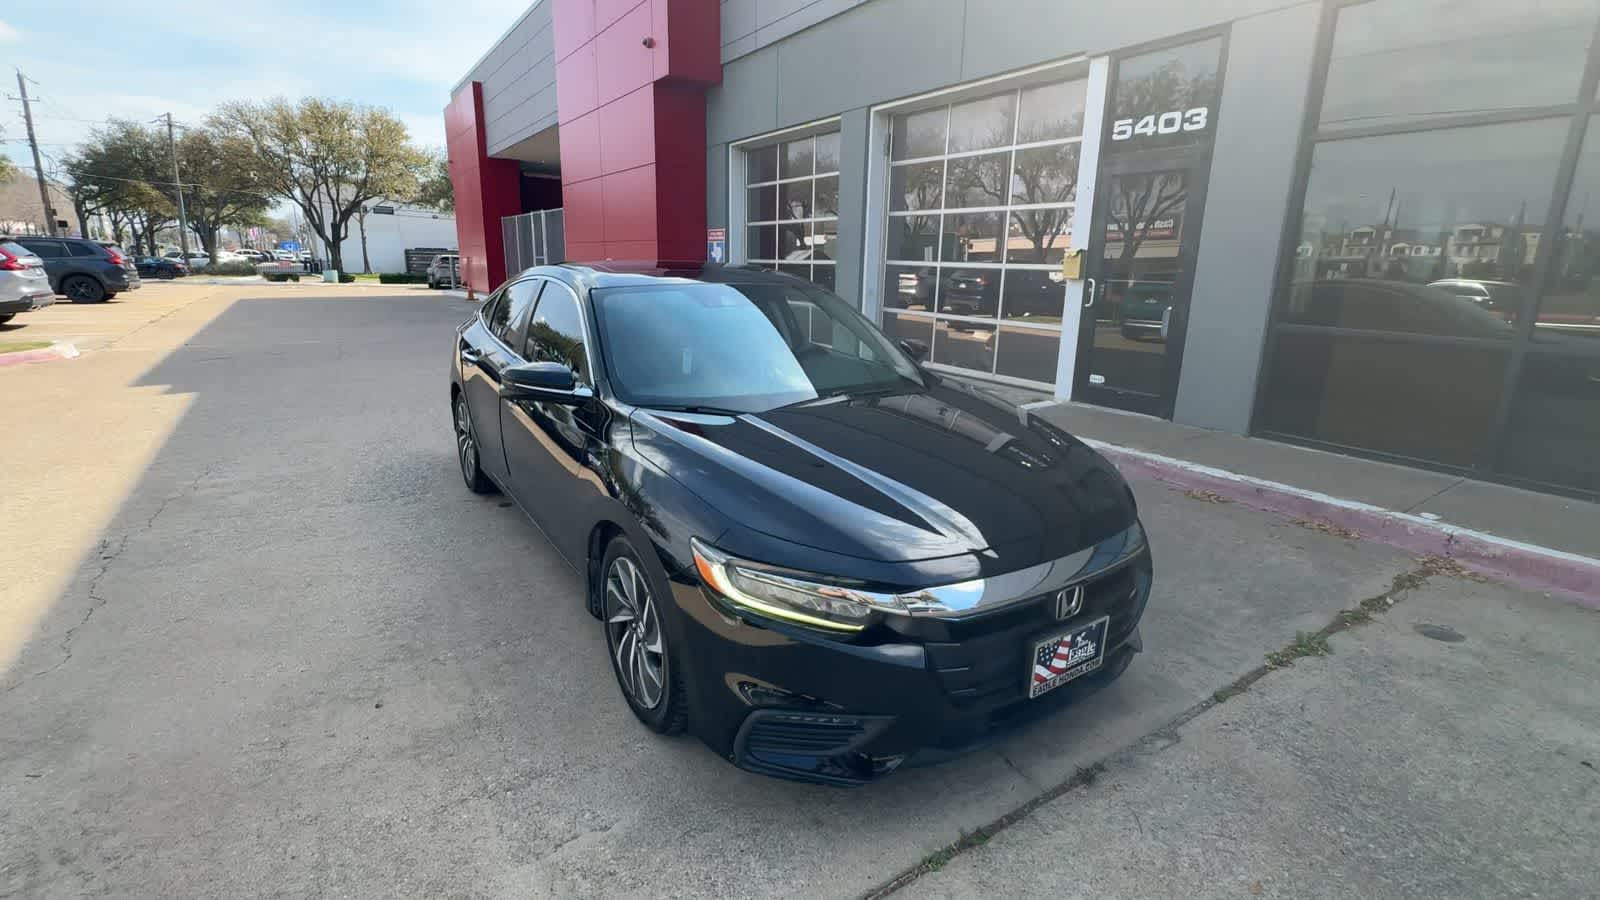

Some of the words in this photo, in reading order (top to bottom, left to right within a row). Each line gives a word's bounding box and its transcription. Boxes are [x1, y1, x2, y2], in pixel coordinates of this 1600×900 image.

[1112, 107, 1208, 140] 5403
[1068, 641, 1097, 661] Eagle
[1032, 679, 1058, 696] EAGLE
